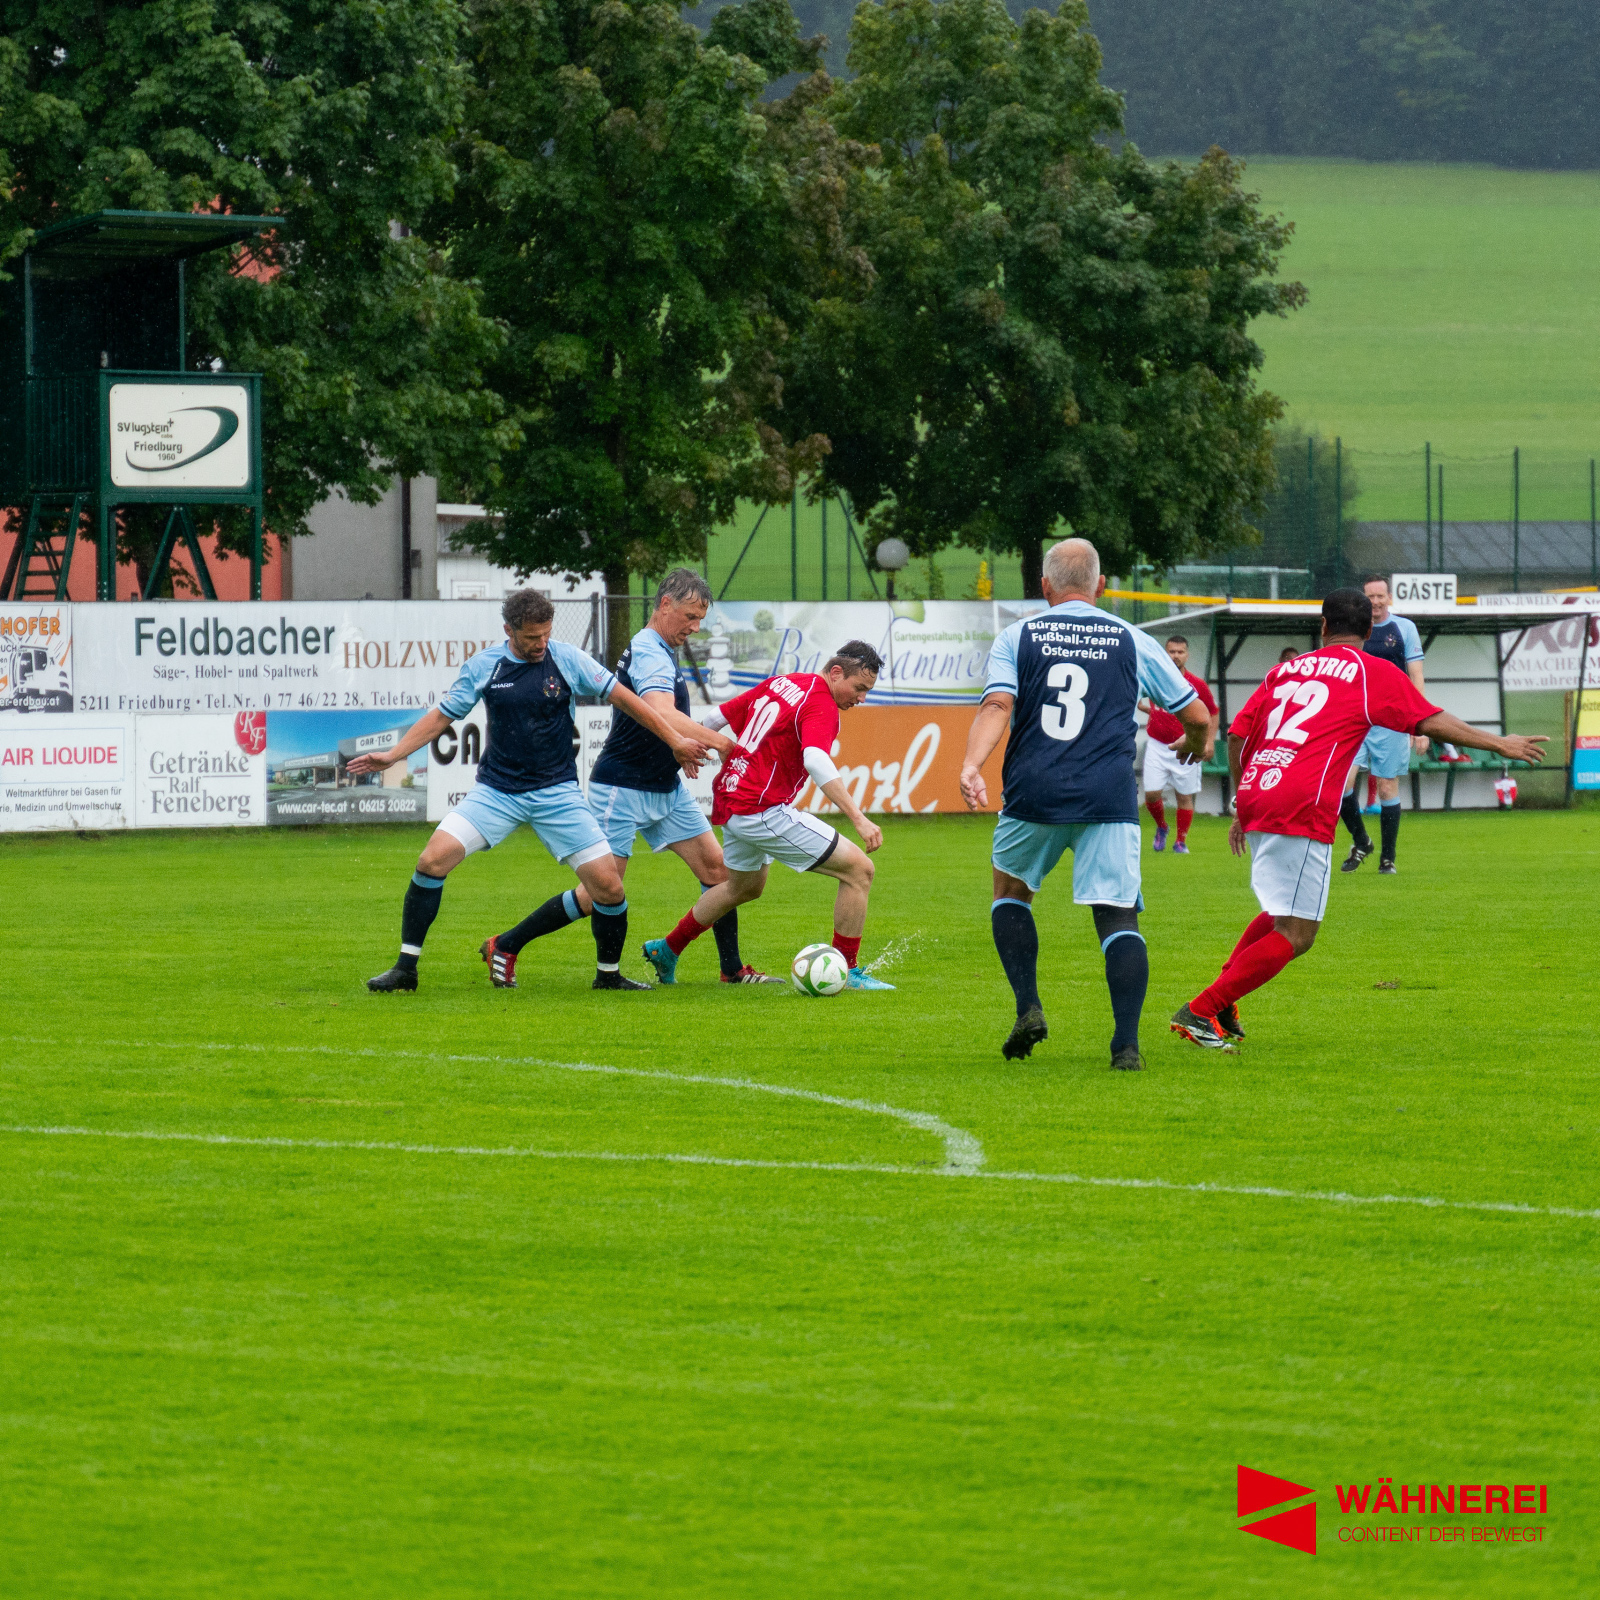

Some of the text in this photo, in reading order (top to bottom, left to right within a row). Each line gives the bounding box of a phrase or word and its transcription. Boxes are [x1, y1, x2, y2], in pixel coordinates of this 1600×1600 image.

[117, 422, 131, 432] SV
[134, 441, 183, 454] Friedburg
[158, 453, 176, 461] 1960
[1396, 578, 1453, 600] GÄSTE
[1027, 620, 1125, 634] Bürgermeister
[134, 616, 335, 656] Feldbacher
[894, 631, 963, 644] Gartengestaltung
[1031, 632, 1120, 647] Fußball-Team
[1041, 645, 1108, 660] Österreich
[153, 663, 318, 682] Säge-, Hobel- und Spaltwerk
[79, 695, 110, 710] 5211
[118, 694, 191, 712] Friedburg
[278, 692, 292, 707] 77
[371, 690, 421, 705] Telefax
[1041, 663, 1089, 741] 3
[1264, 680, 1329, 745] 12
[737, 694, 780, 754] 10
[1, 746, 118, 766] AIR LIQUIDE
[149, 751, 250, 774] Getränke
[5, 786, 122, 798] Weltmarktführer bei Gasen für
[168, 776, 201, 793] Ralf
[15, 803, 46, 812] Medizin
[48, 803, 64, 812] und
[65, 801, 122, 812] Umweltschutz
[150, 790, 251, 818] Feneberg
[276, 799, 347, 814] www.car-tec.at
[358, 799, 386, 812] 06215
